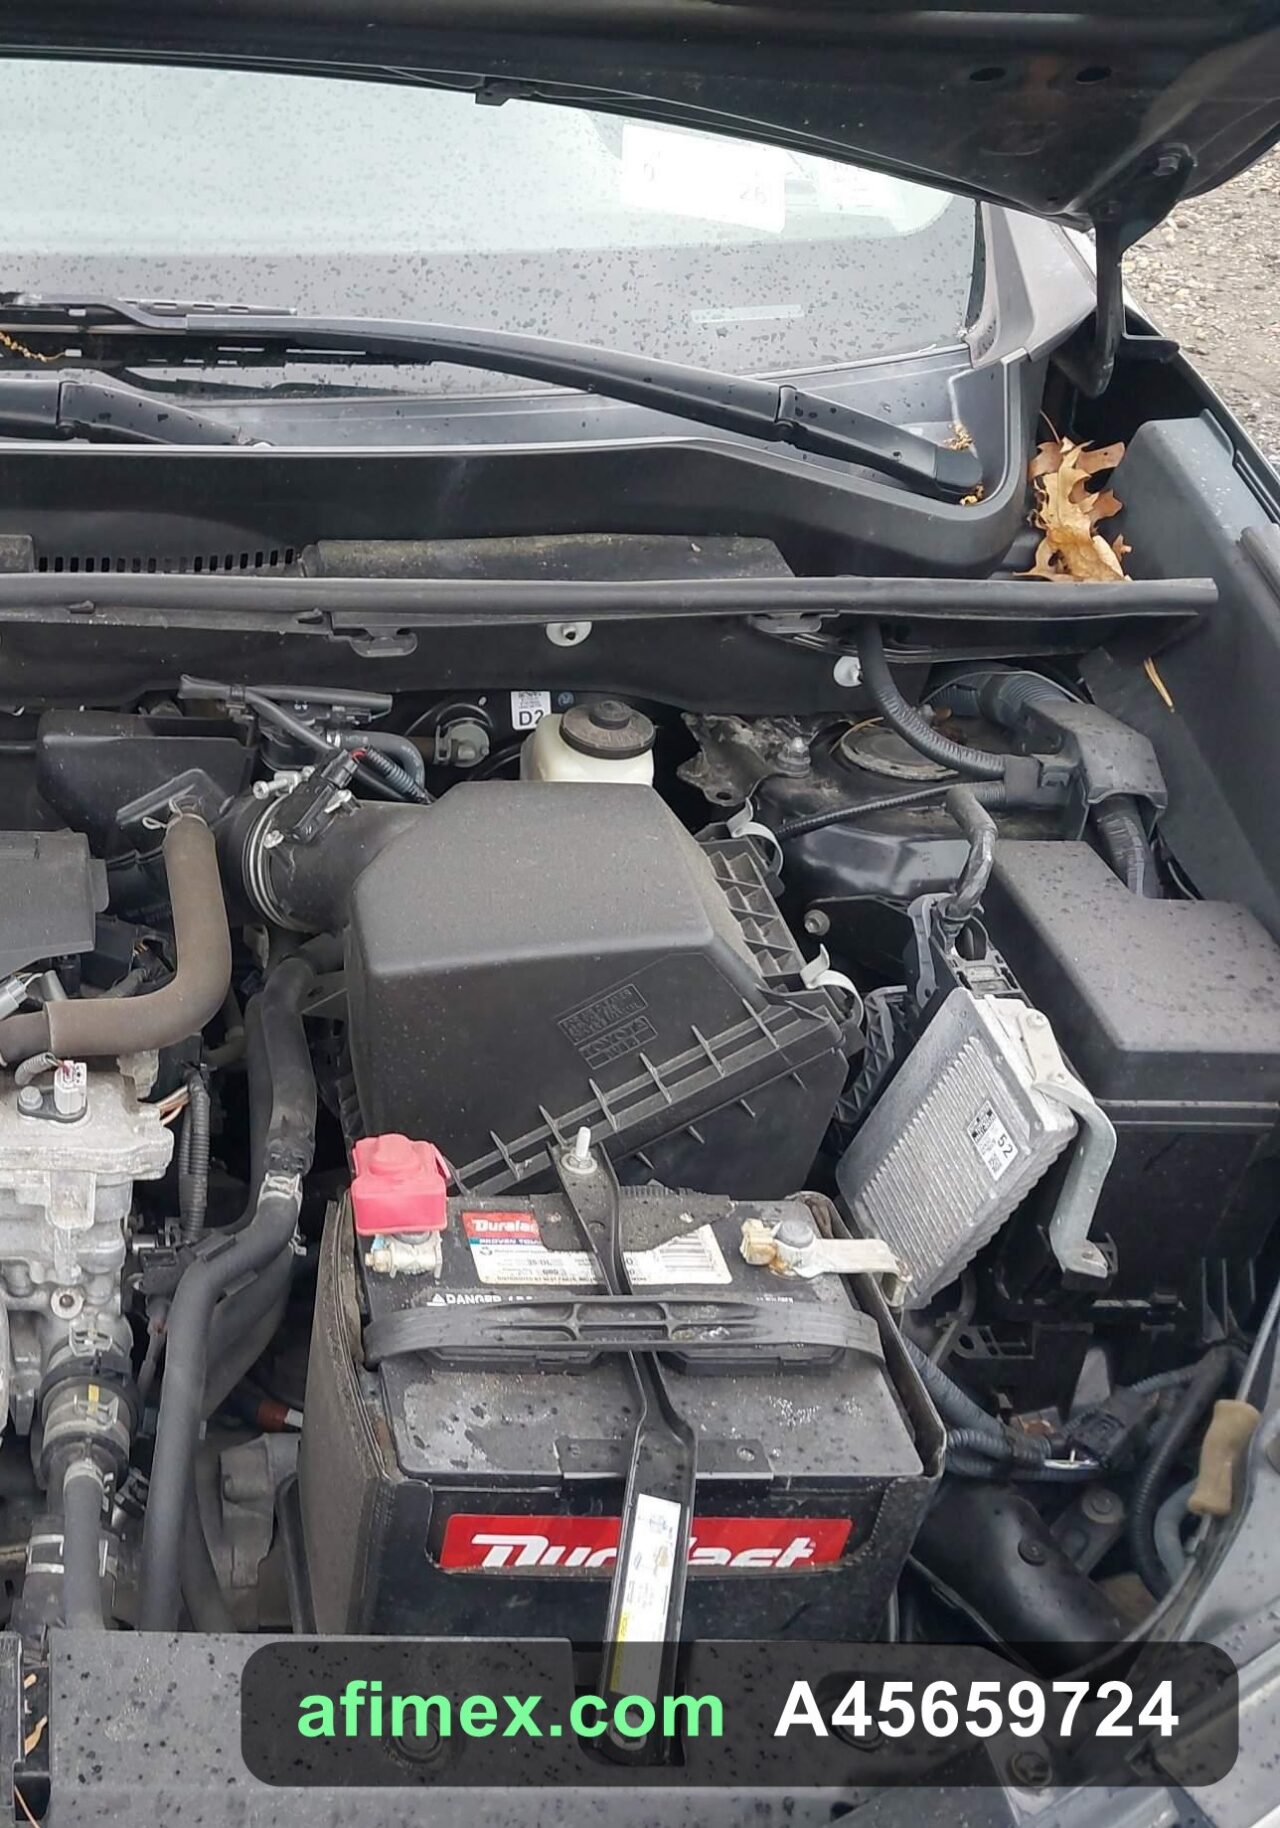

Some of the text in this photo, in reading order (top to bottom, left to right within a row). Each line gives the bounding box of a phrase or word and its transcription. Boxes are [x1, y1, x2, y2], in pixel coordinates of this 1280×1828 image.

[519, 709, 544, 726] D2
[997, 1133, 1014, 1159] 52
[472, 1218, 538, 1232] Durala
